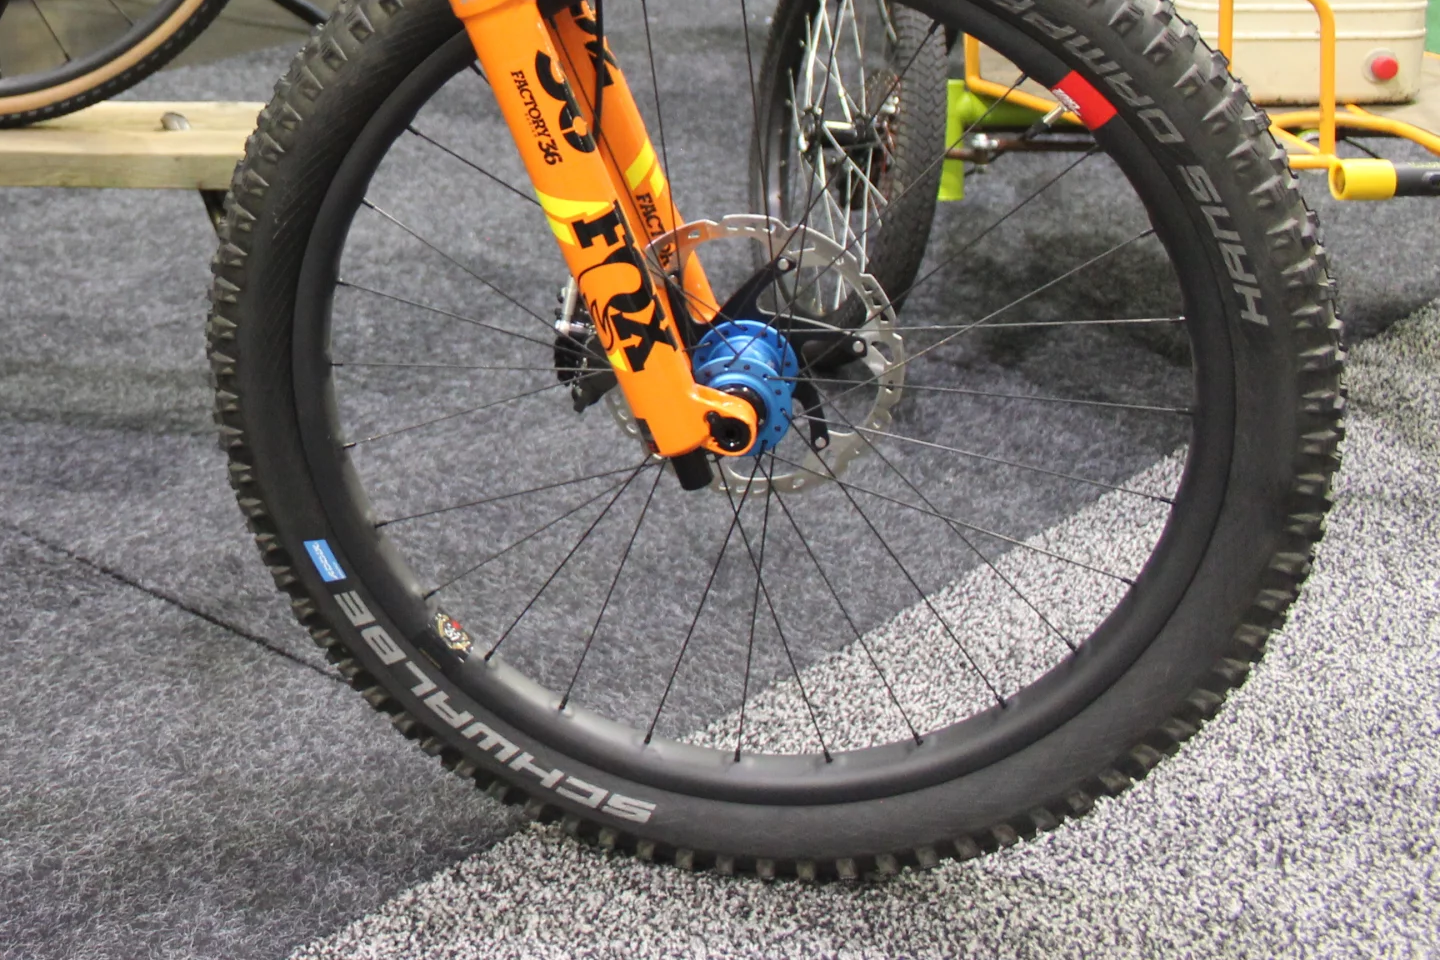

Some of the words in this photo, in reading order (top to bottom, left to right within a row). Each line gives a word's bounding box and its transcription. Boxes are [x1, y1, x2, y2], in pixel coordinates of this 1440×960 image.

[510, 69, 552, 140] FACTORY
[538, 138, 564, 166] 36
[572, 199, 679, 373] FOX
[1177, 164, 1270, 327] HANS
[333, 589, 658, 824] SCHWALBE
